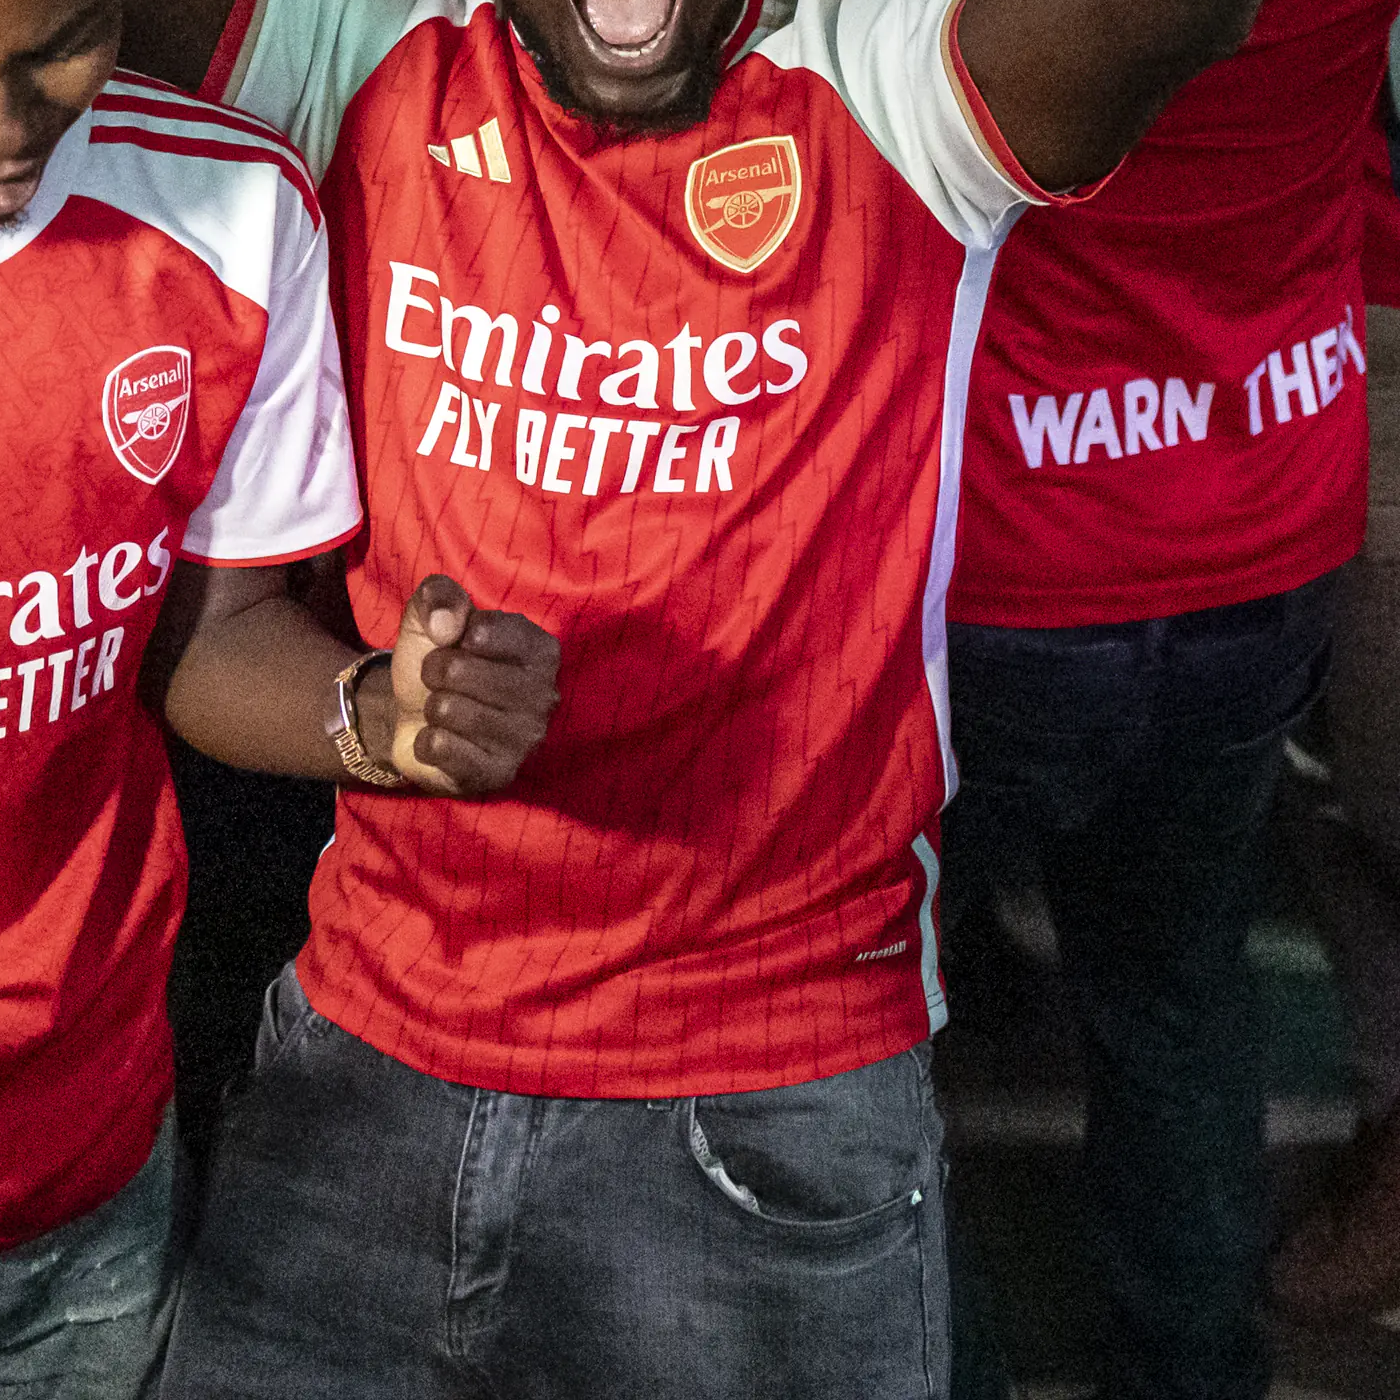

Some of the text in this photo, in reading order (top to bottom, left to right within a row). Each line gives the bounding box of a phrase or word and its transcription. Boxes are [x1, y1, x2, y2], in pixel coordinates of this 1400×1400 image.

[705, 157, 778, 187] Arsenal
[119, 362, 181, 398] Arsenal
[385, 260, 808, 412] Emirates
[416, 381, 741, 497] FLY BETTER
[1008, 377, 1216, 469] WARN
